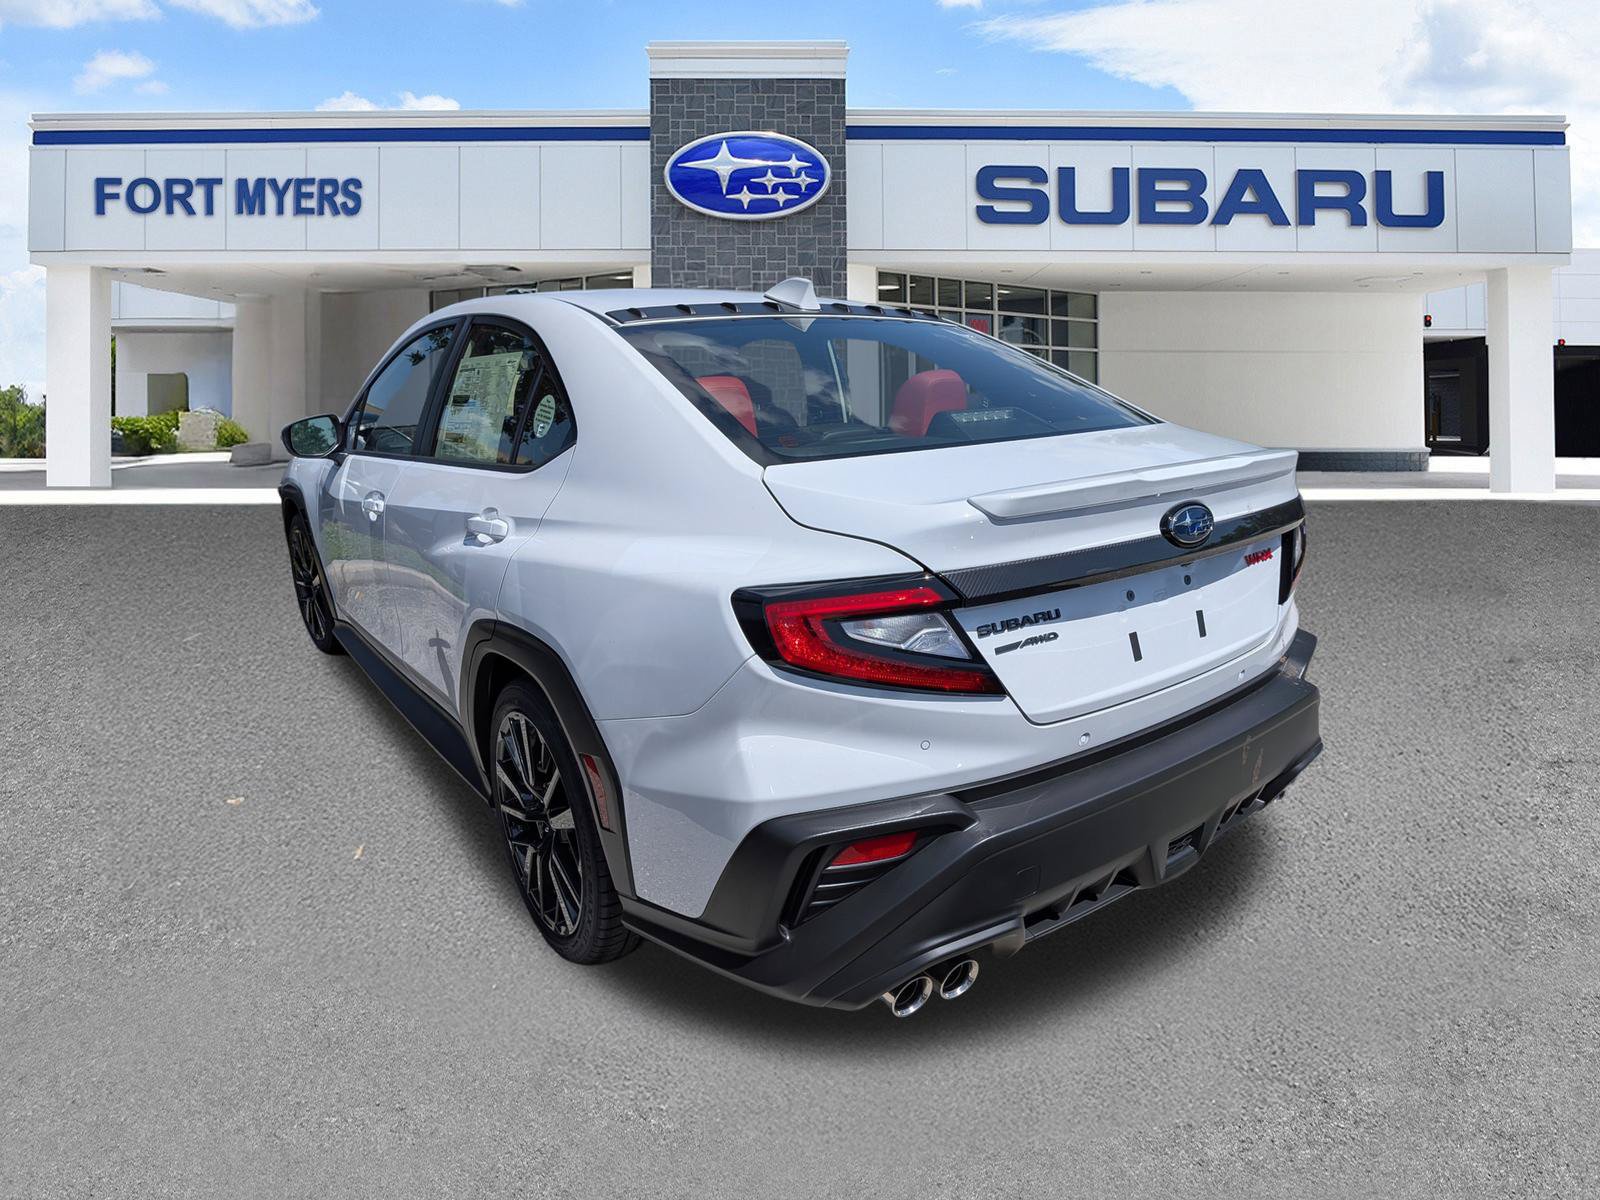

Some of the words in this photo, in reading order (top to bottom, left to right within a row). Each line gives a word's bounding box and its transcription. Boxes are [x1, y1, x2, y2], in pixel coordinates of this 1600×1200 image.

[94, 177, 223, 216] FORT
[234, 177, 363, 217] MYERS
[975, 165, 1445, 228] SUBARU
[1245, 548, 1273, 566] WRX
[977, 608, 1061, 638] SUBARU
[1019, 631, 1060, 650] AWD
